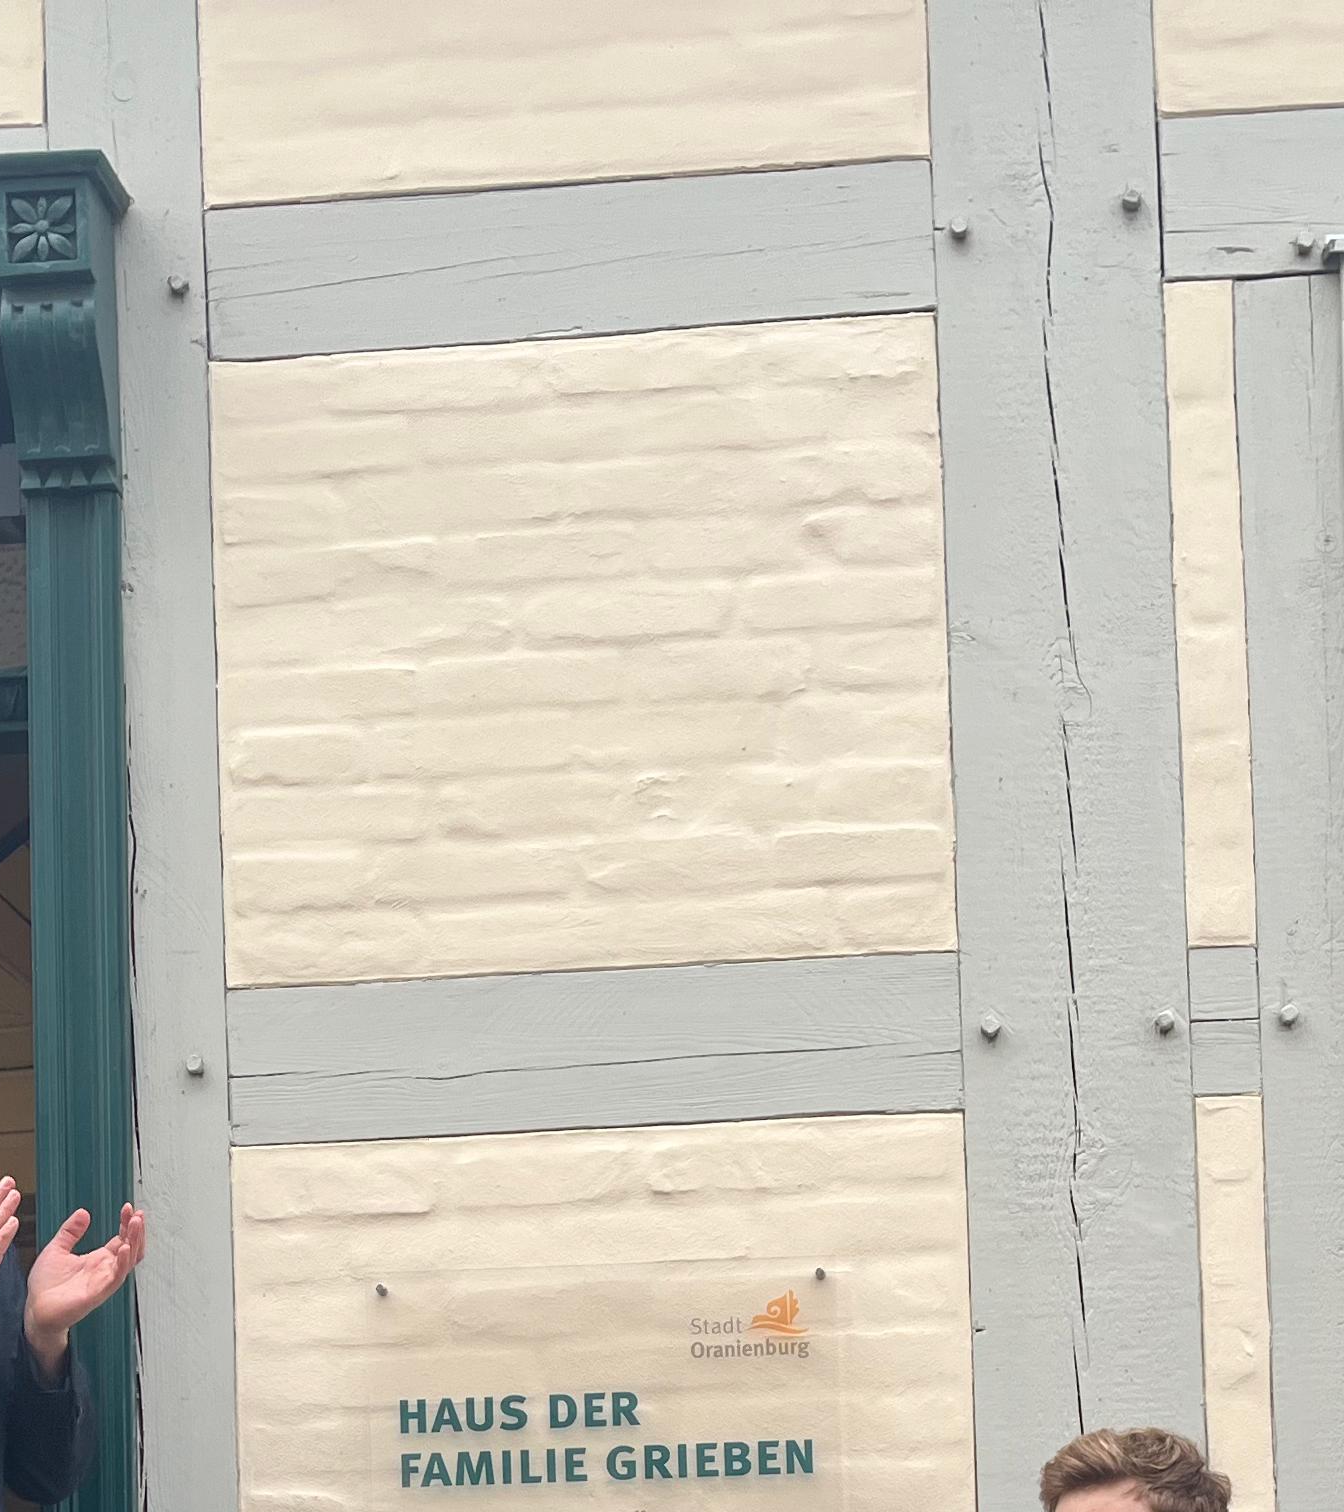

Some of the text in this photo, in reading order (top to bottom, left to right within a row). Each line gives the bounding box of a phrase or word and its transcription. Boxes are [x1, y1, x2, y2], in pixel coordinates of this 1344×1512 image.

[690, 1316, 743, 1335] Stadt
[690, 1338, 810, 1359] Oranienburg
[399, 1391, 640, 1434] HAUS DER
[400, 1439, 814, 1488] FAMILIE GRIEBEN
